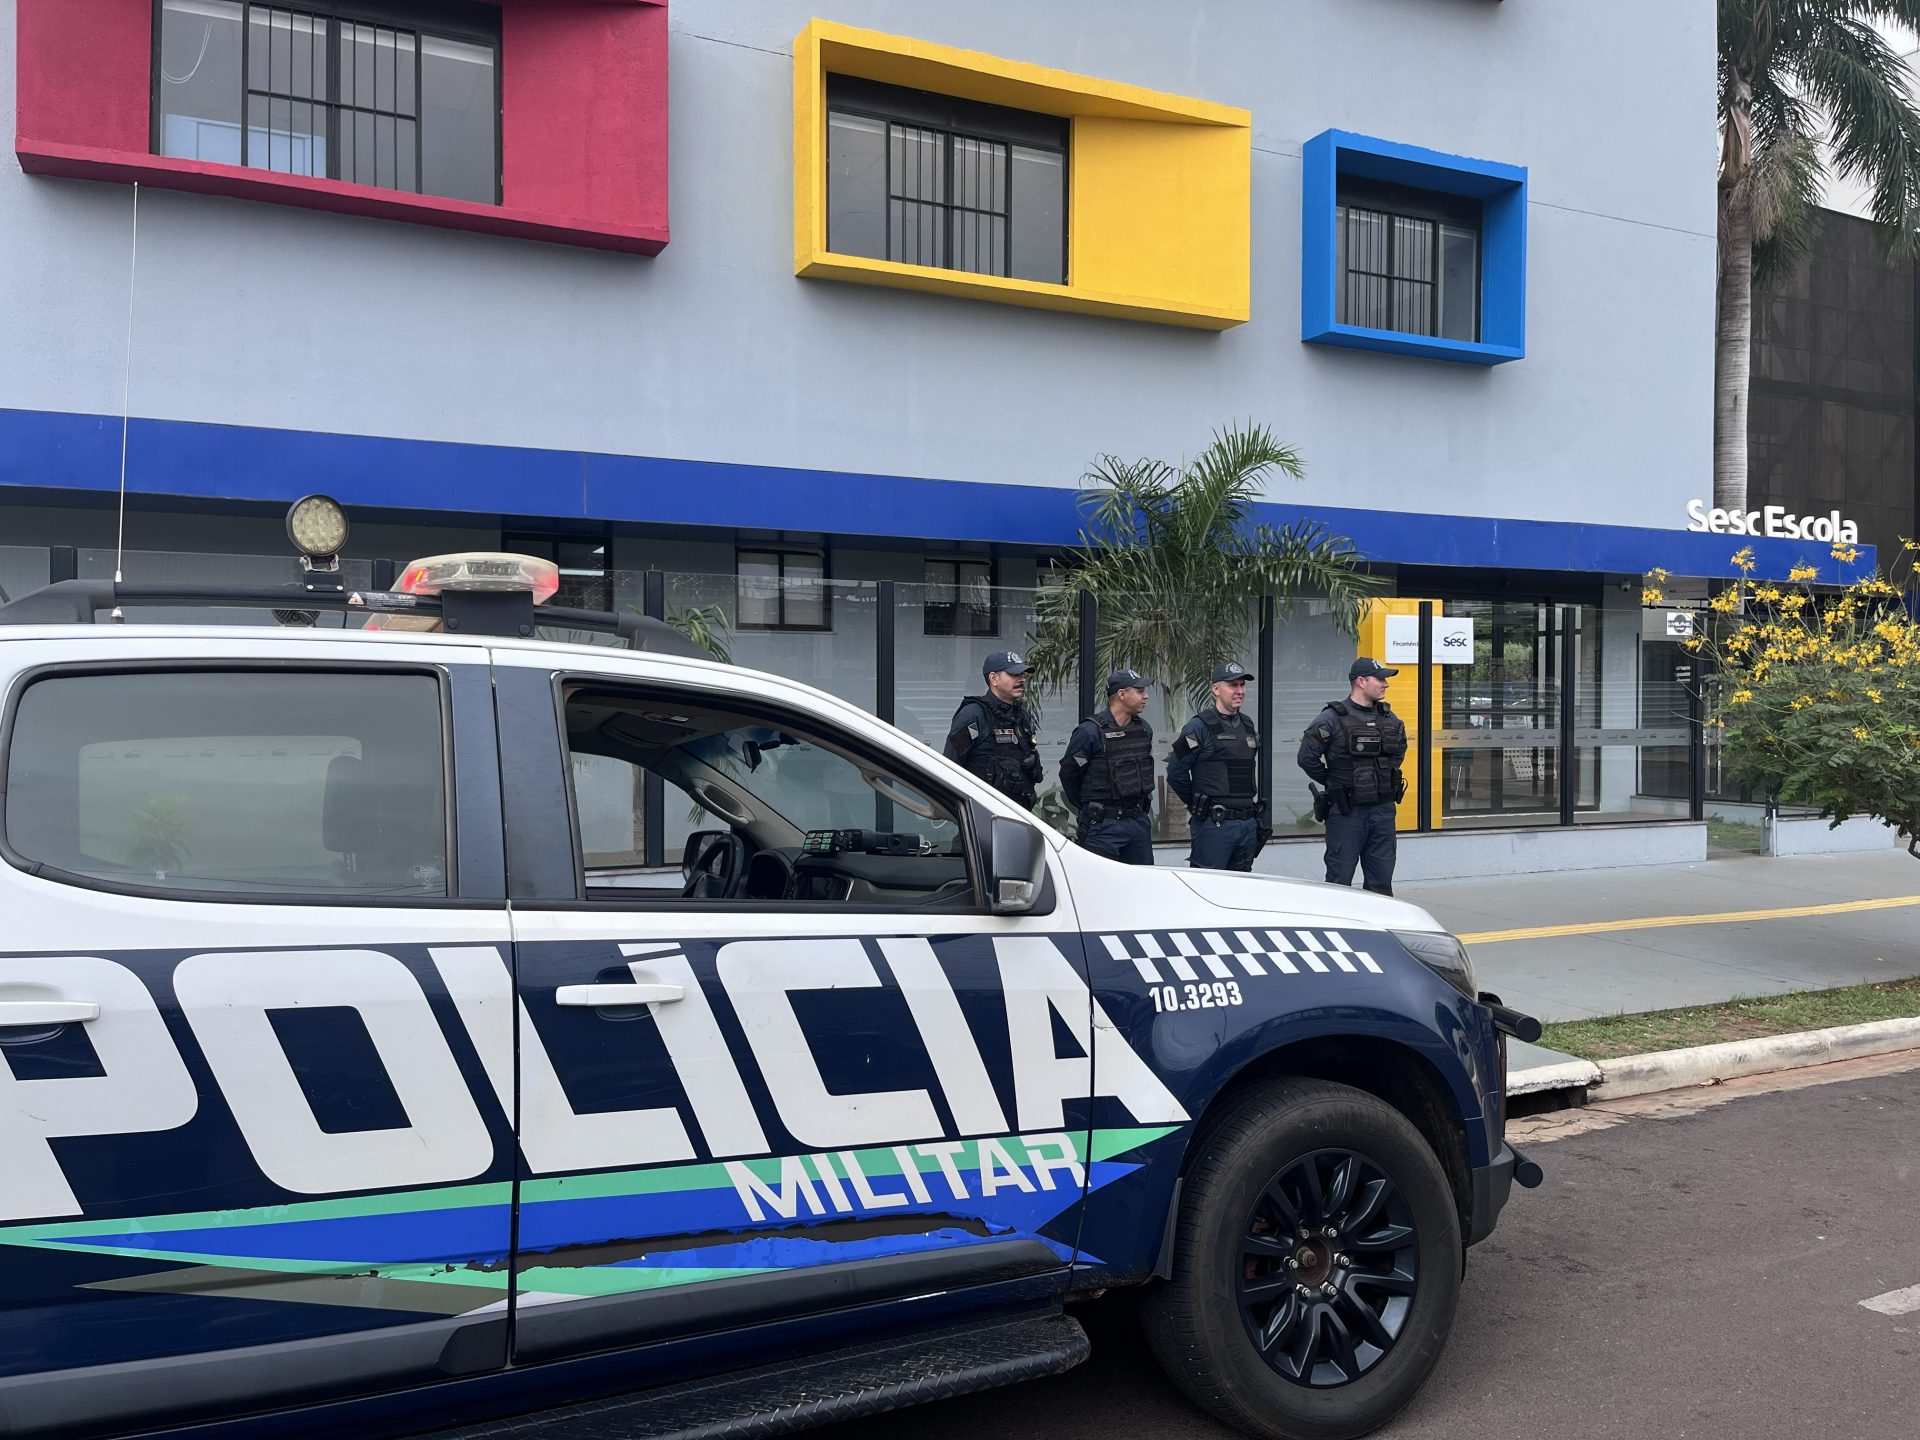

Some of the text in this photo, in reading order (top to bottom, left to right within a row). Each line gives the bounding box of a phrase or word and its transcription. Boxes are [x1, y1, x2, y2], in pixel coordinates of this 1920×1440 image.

[1686, 498, 1858, 544] Sesc Escola
[1443, 636, 1467, 647] Sesc
[1148, 981, 1243, 1013] 10.3293
[723, 1132, 1092, 1222] MILITAR
